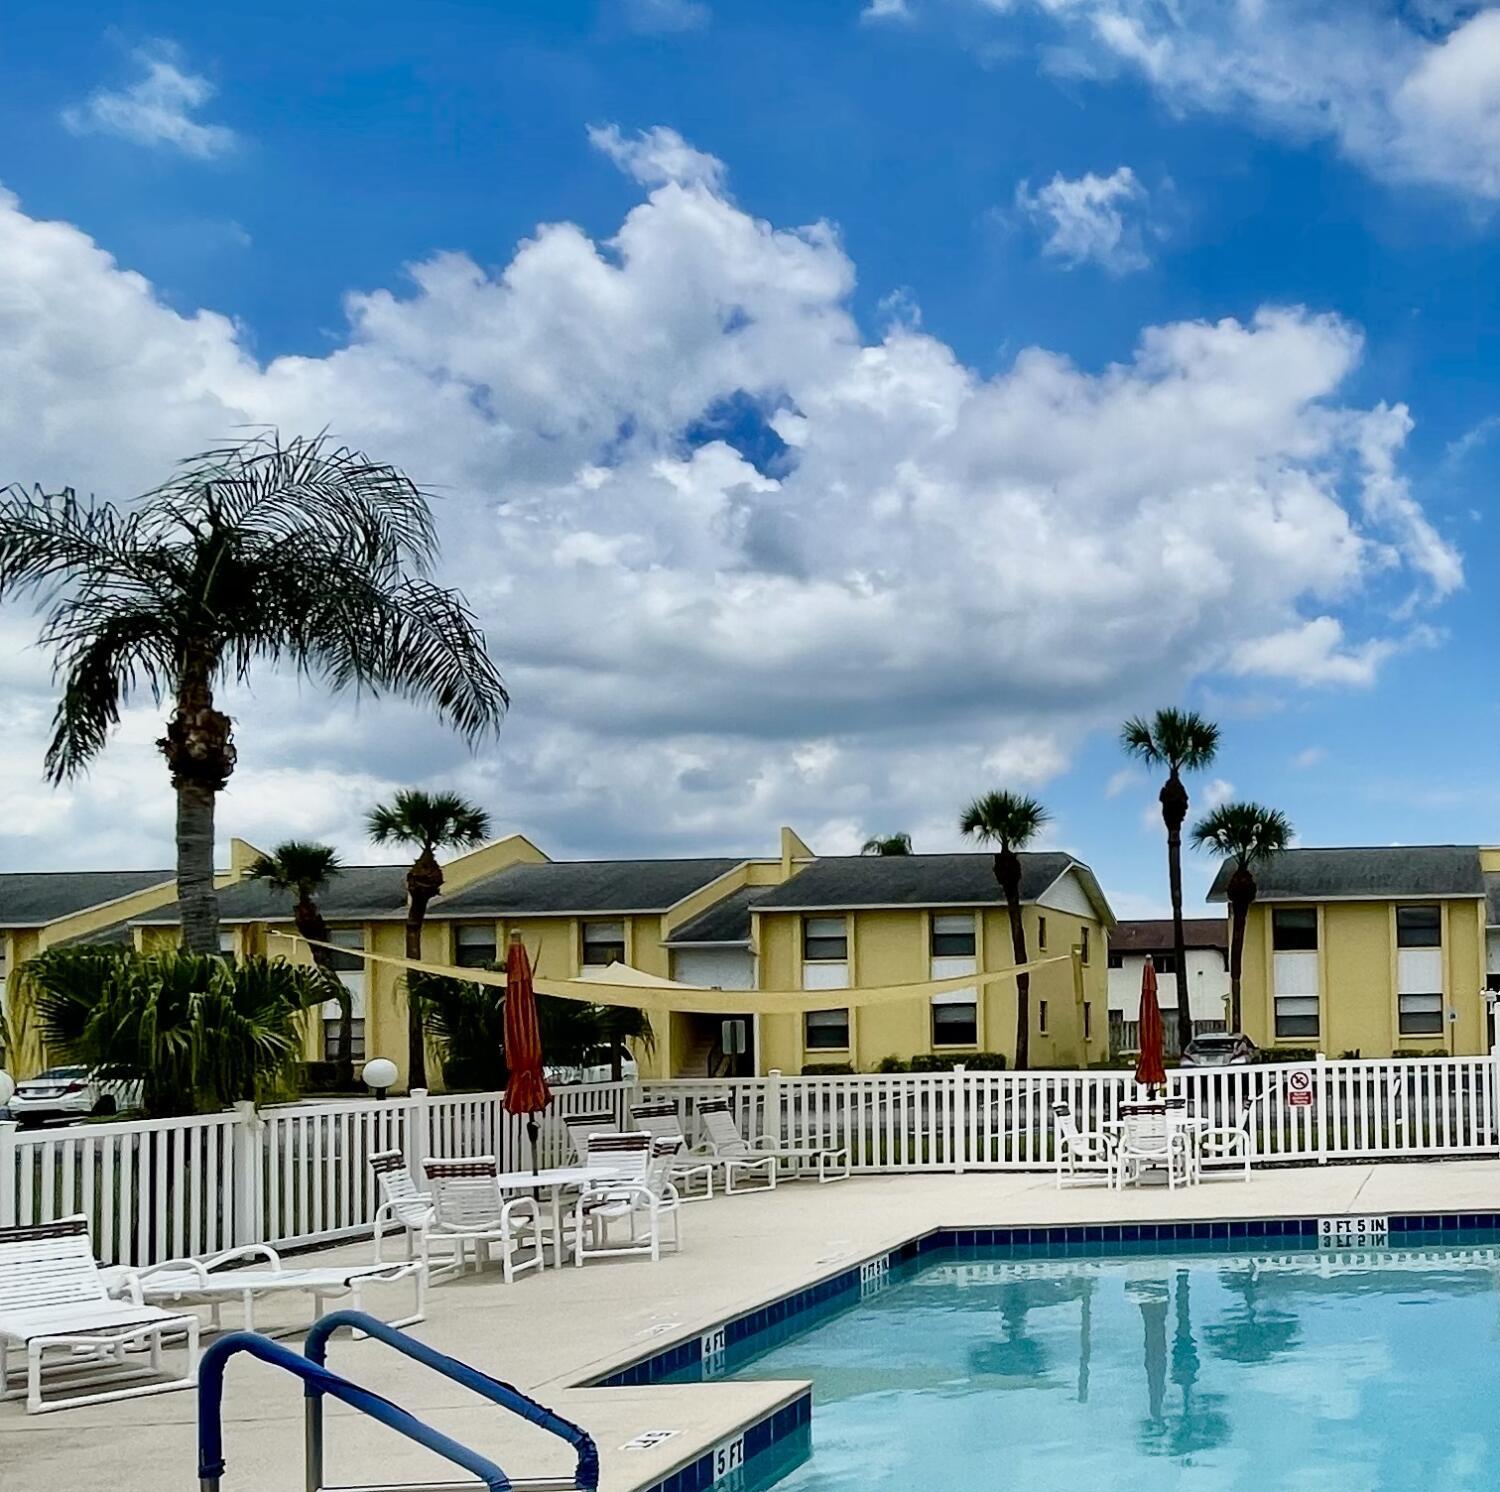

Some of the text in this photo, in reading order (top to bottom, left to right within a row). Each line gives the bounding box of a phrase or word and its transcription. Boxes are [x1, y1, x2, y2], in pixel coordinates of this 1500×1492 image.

[1323, 1220, 1331, 1234] 3
[1357, 1219, 1366, 1233] 5
[704, 1337, 711, 1354] 4
[717, 1448, 725, 1475] 5
